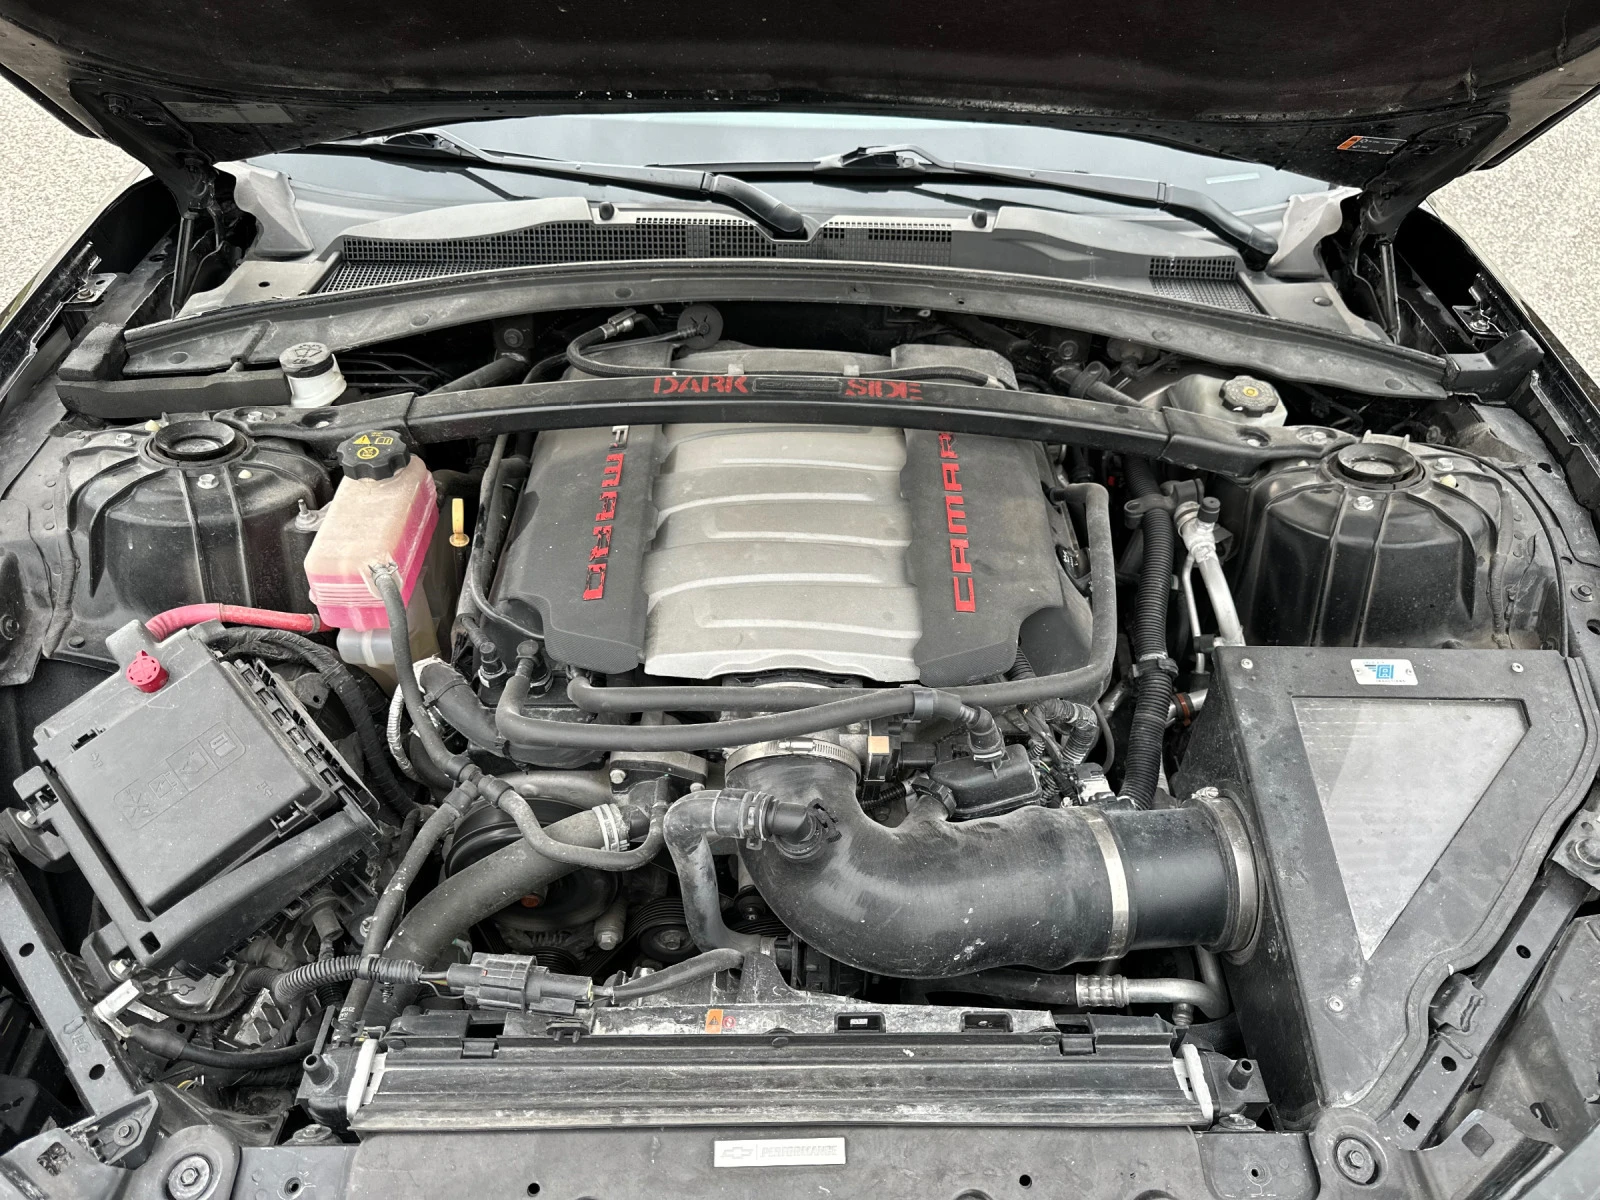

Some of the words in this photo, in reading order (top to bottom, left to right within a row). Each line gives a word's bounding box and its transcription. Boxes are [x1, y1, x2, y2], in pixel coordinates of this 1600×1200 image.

[653, 376, 748, 394] DARK
[845, 379, 923, 400] SIDE
[583, 425, 629, 600] AMARO
[938, 433, 976, 612] CAMAR
